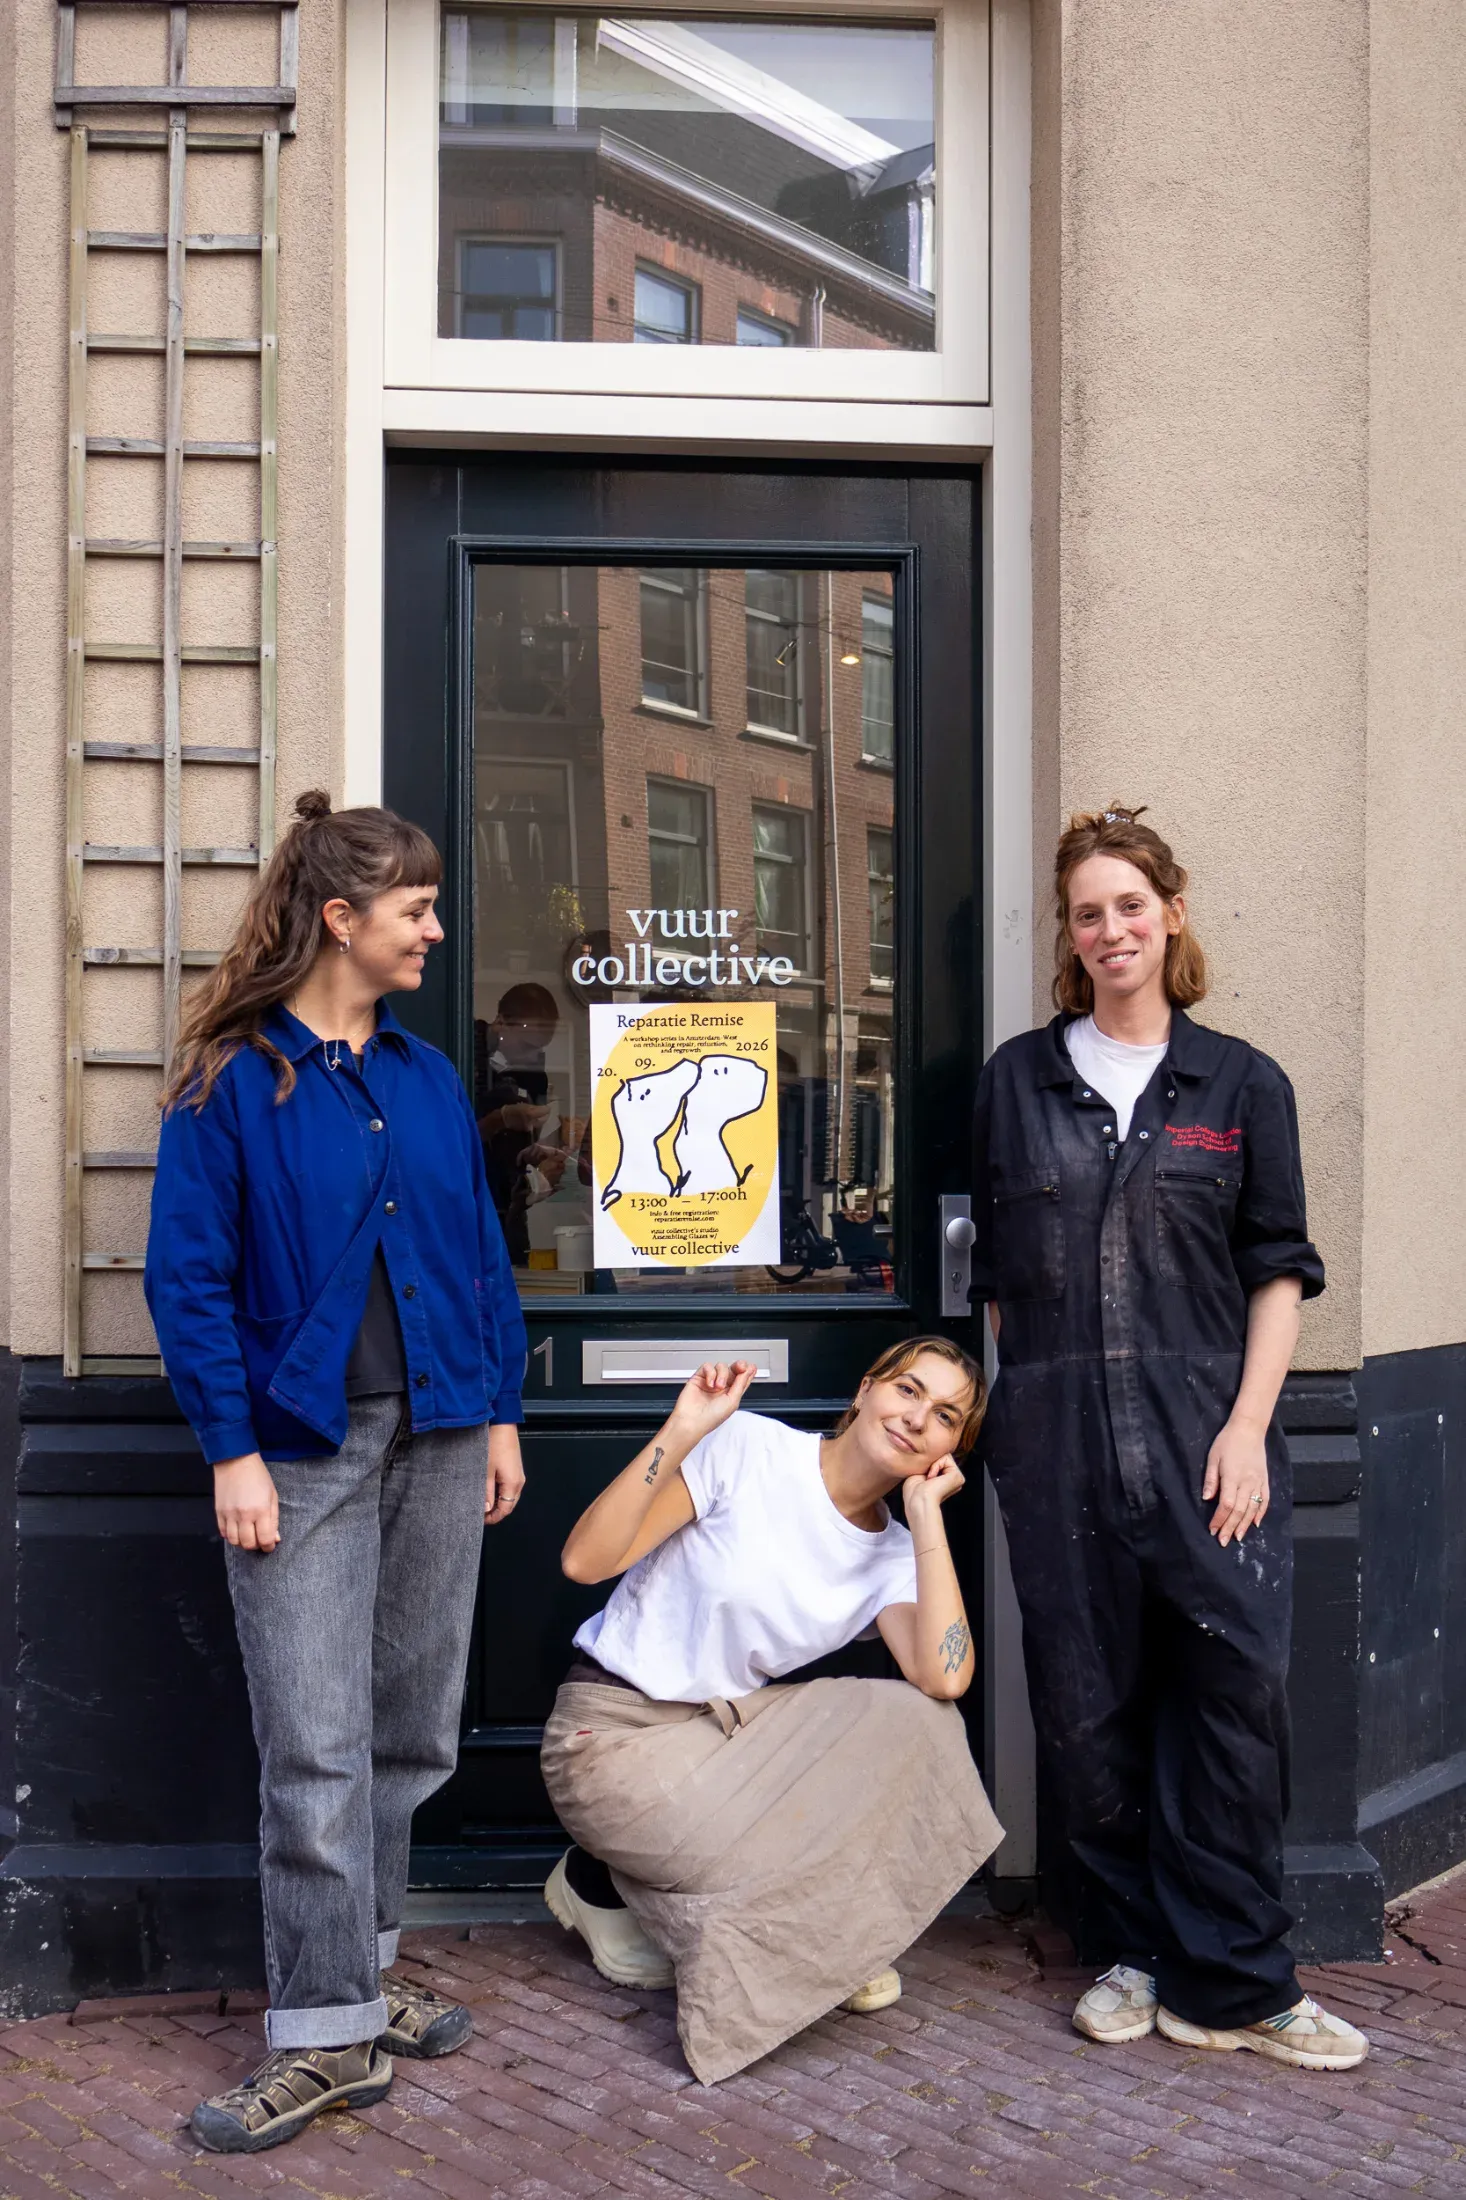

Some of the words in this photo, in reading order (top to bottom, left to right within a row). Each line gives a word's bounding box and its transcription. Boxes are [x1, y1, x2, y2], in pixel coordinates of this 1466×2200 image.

[626, 909, 738, 938] vuur
[572, 943, 794, 986] collective
[617, 1014, 686, 1030] Reparatie
[691, 1014, 744, 1027] Remise
[597, 1068, 617, 1077] 20.
[635, 1058, 656, 1070] 09.
[736, 1038, 768, 1051] 2026
[1165, 1124, 1193, 1134] Imperial
[1171, 1139, 1198, 1147] Design
[1202, 1133, 1223, 1145] School
[631, 1198, 667, 1211] 13:00
[700, 1188, 747, 1204] 17:00h
[631, 1245, 666, 1256] vuur
[671, 1241, 739, 1255] collective
